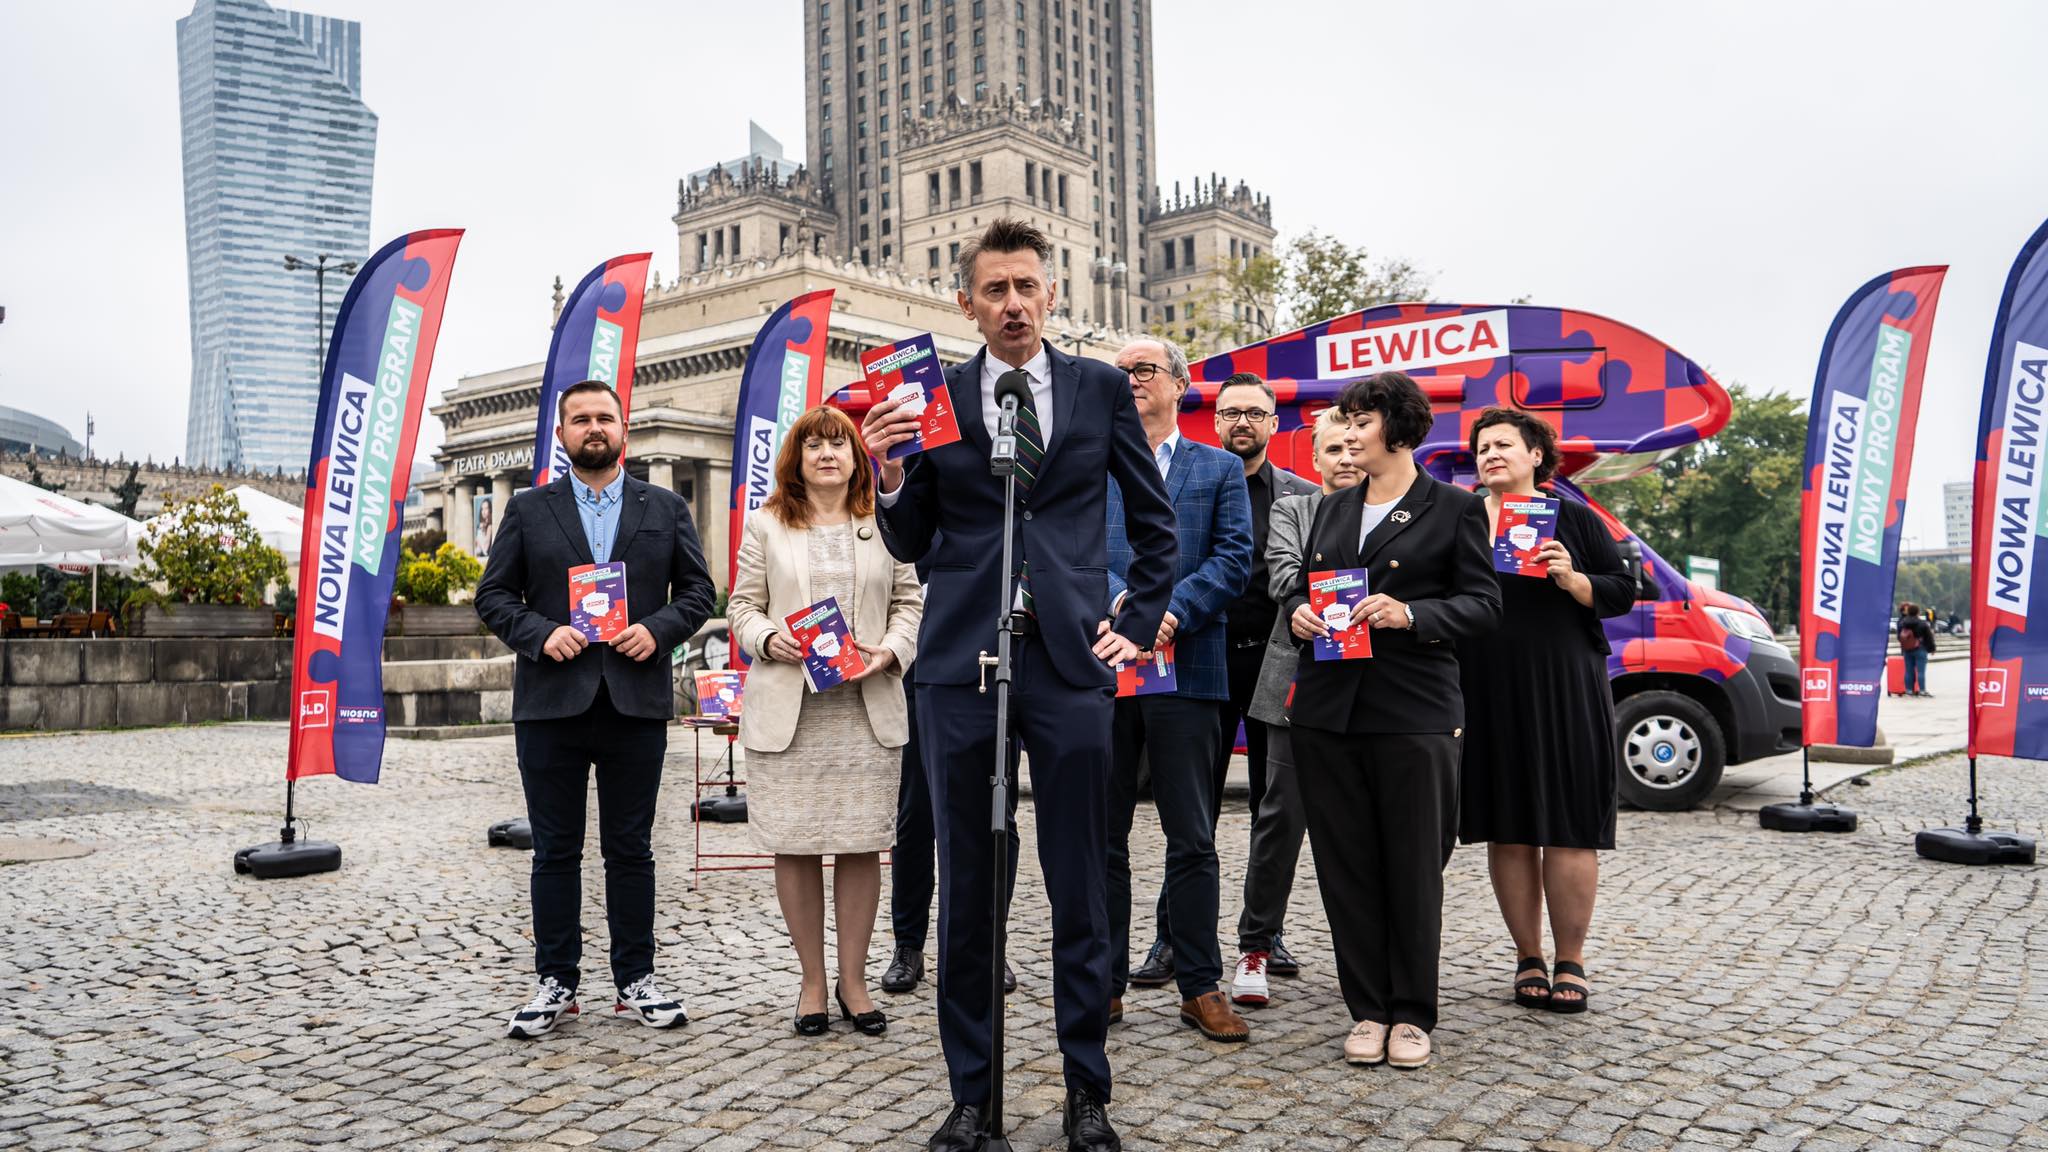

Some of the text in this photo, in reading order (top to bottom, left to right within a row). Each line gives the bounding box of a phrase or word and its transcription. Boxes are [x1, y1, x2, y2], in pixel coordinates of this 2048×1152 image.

[868, 346, 917, 372] NOWA LEWICA
[881, 362, 901, 374] NOWY
[901, 348, 931, 366] PROGRAM
[1328, 319, 1499, 372] LEWICA
[359, 305, 417, 565] NOWY PROGRAM
[453, 455, 487, 474] TEATR
[492, 448, 536, 469] DRAMA
[749, 428, 772, 511] EWICA
[1855, 331, 1905, 556] NOWY PROGRAM
[315, 391, 368, 627] NOWA LEWICA
[1820, 406, 1860, 612] NOWA LEWICA
[1995, 360, 2048, 603] NOWA LEWICA
[793, 607, 827, 629] NOWA LEWICA
